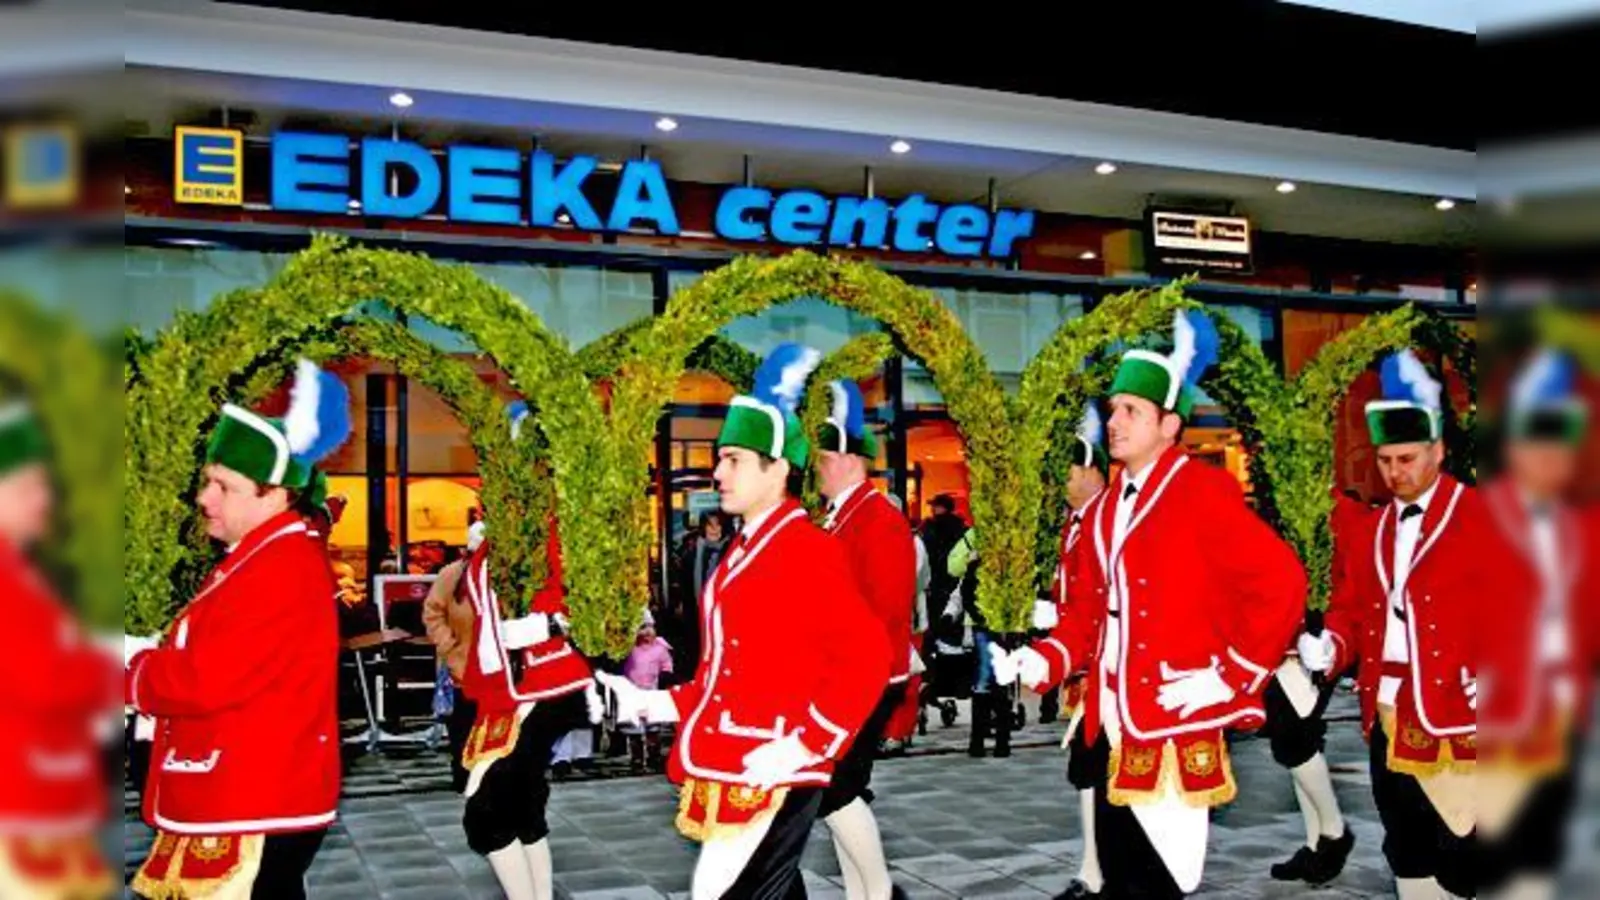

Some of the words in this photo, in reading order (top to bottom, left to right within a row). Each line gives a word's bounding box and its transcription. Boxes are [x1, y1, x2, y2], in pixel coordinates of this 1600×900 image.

[182, 188, 238, 200] EDEKA
[271, 131, 680, 235] EDEKA
[714, 185, 1036, 258] center
